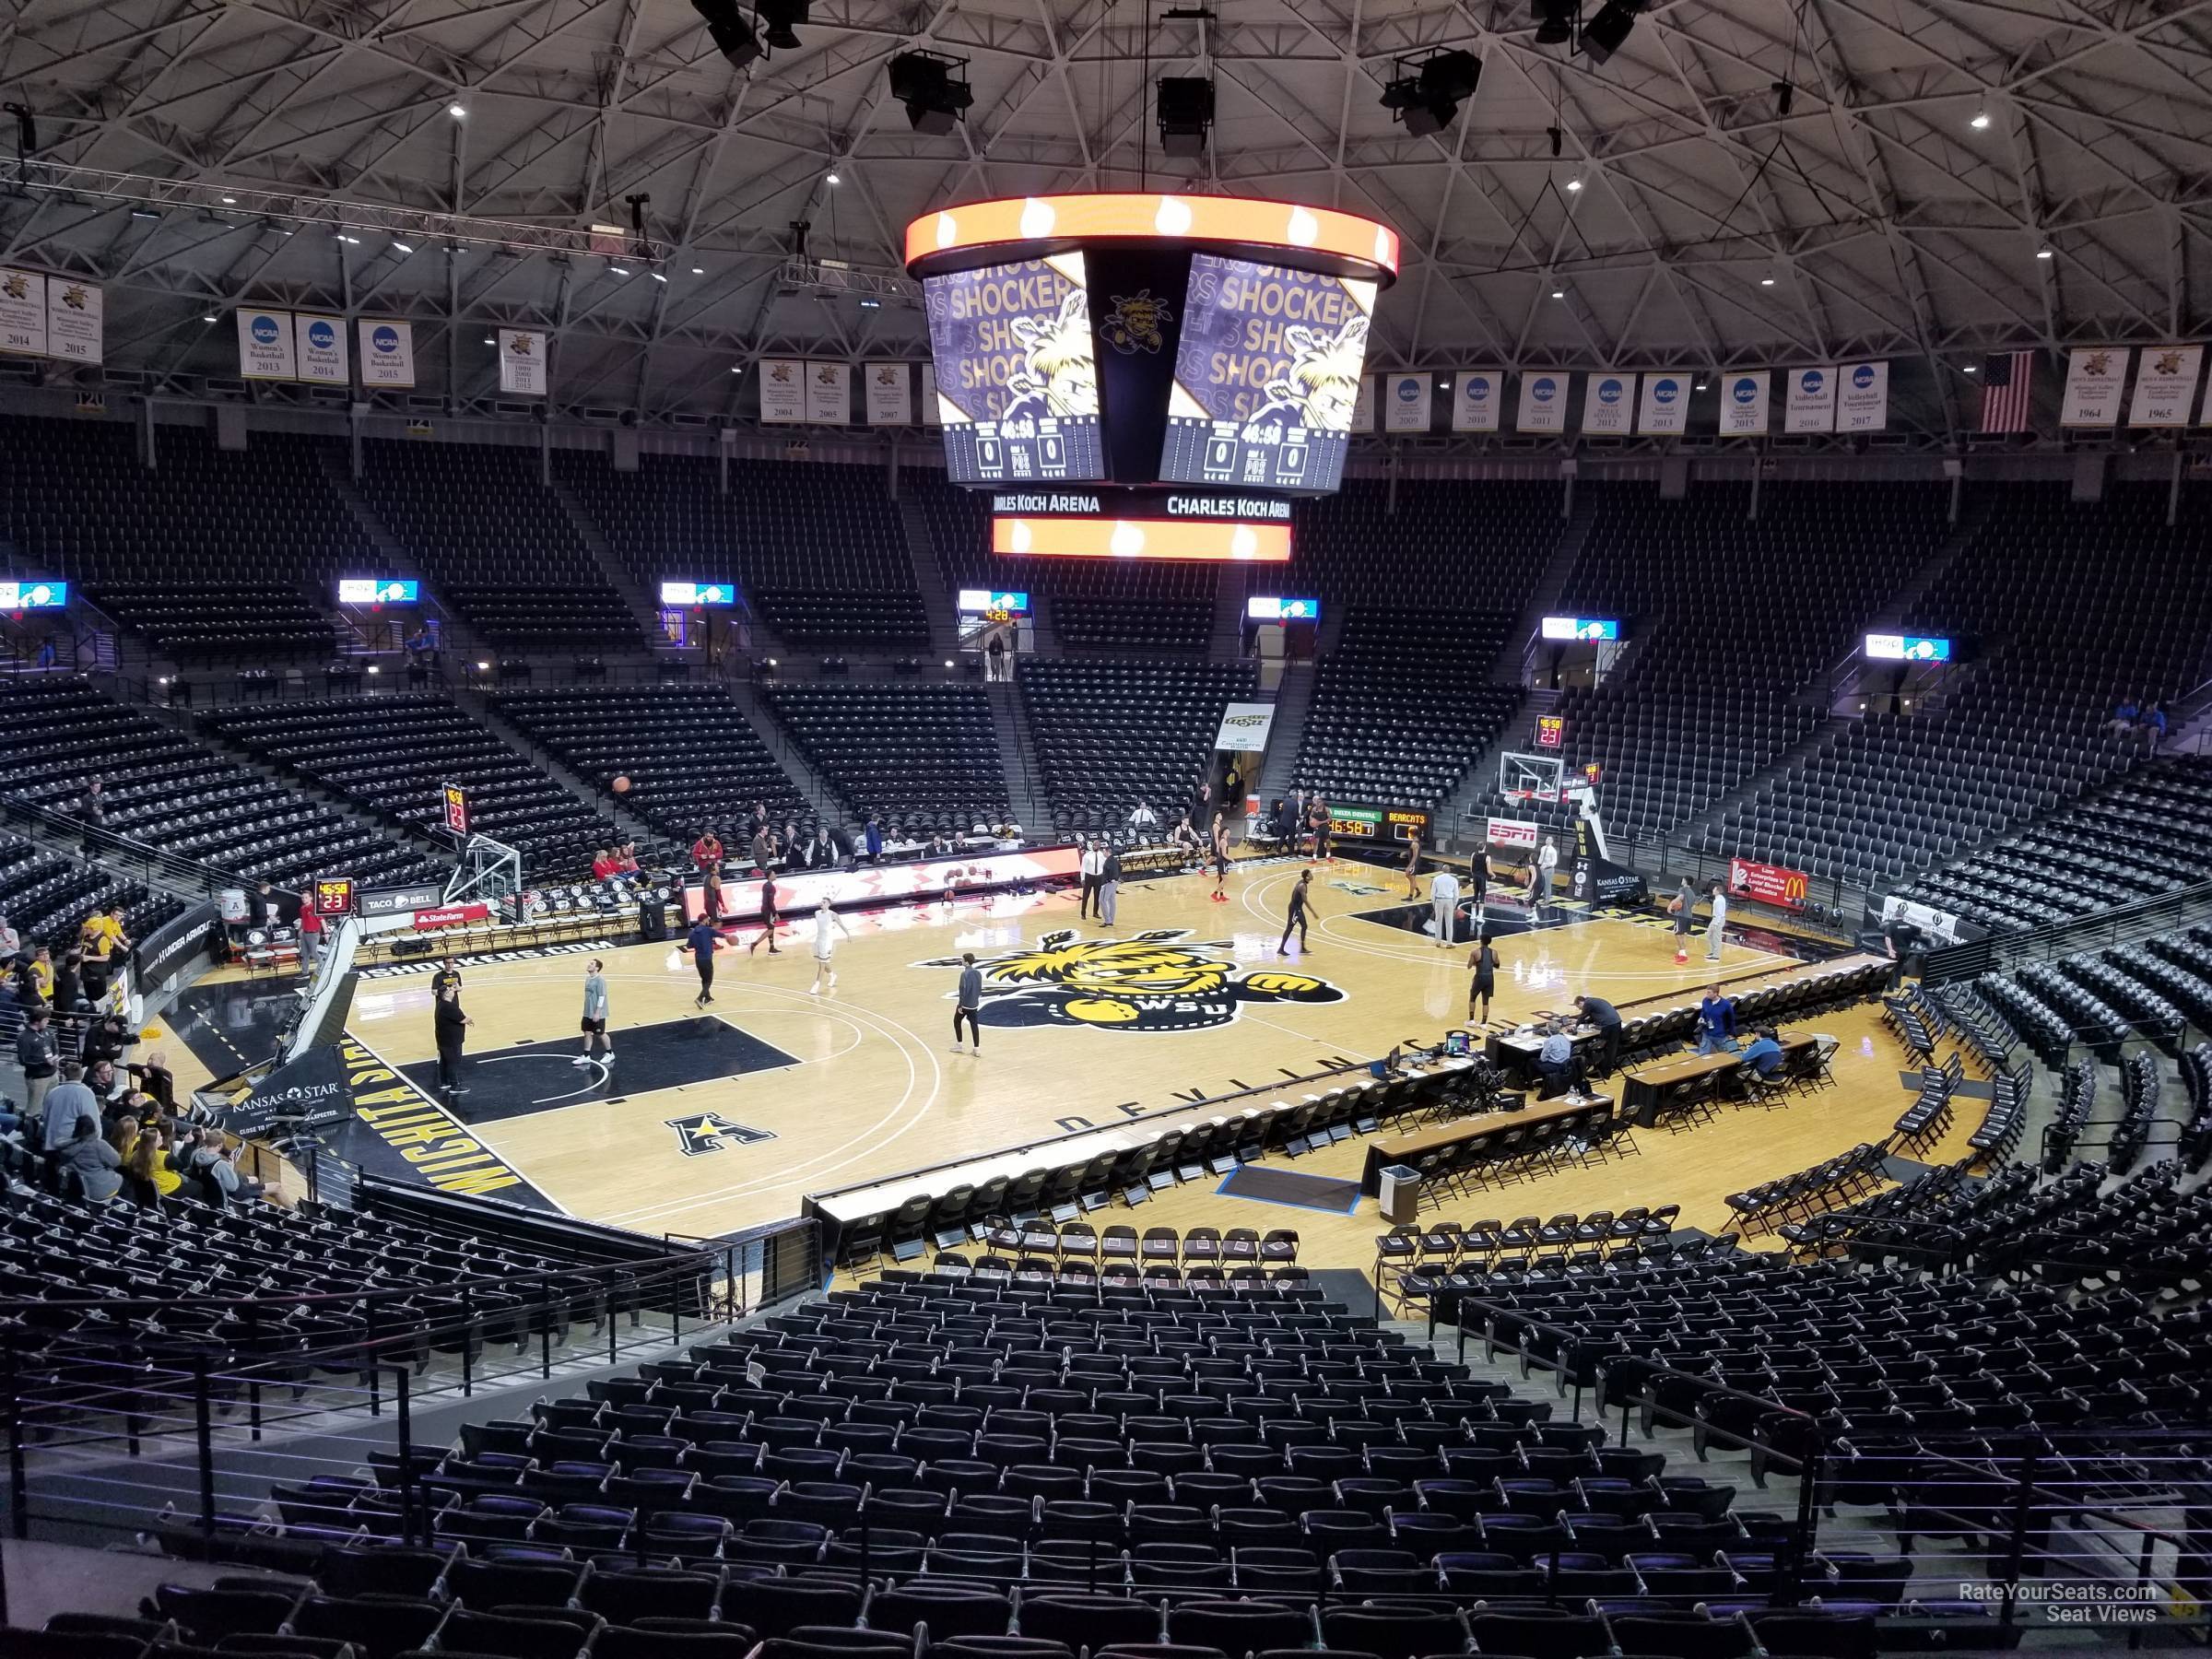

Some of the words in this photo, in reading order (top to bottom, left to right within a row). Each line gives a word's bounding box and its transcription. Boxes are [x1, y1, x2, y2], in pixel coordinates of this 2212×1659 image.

[254, 329, 278, 337] NCAA
[312, 334, 335, 342] NCAA
[7, 334, 29, 346] 2014
[375, 338, 397, 347] NCAA
[65, 343, 87, 355] 2015
[251, 343, 283, 352] Women's
[251, 351, 285, 359] Basketball
[308, 355, 339, 364] Basketball
[371, 359, 404, 368] Basketball
[312, 366, 335, 375] 2014
[378, 370, 398, 379] 2015
[2078, 408, 2101, 418] 1964
[2148, 408, 2173, 418] 1965
[1851, 416, 1871, 426] 2017
[984, 441, 994, 461] 0
[1046, 439, 1056, 460] 0
[1216, 442, 1228, 463] 0
[1287, 448, 1299, 468] 0
[1017, 494, 1046, 512] KOCH
[1048, 494, 1100, 512] ARENA
[1167, 496, 1235, 516] CHARLES
[1237, 498, 1267, 517] KOCH
[985, 609, 1008, 620] 4:28
[1540, 728, 1557, 744] 23
[451, 804, 464, 829] 23
[1352, 811, 1376, 819] DENTAL
[1389, 812, 1425, 824] BEARCATS
[1489, 823, 1536, 841] ESPN
[1596, 877, 1618, 886] KANSAS
[320, 883, 347, 895] 46:58
[324, 895, 342, 909] 23
[369, 900, 393, 909] TACO
[409, 894, 431, 904] BELL
[164, 936, 185, 957] UNDER
[1134, 999, 1228, 1015] WSU
[304, 1082, 339, 1099] STAR
[240, 1126, 257, 1135] CLOSE
[258, 1124, 265, 1133] TO
[354, 1085, 523, 1194] WICHITA
